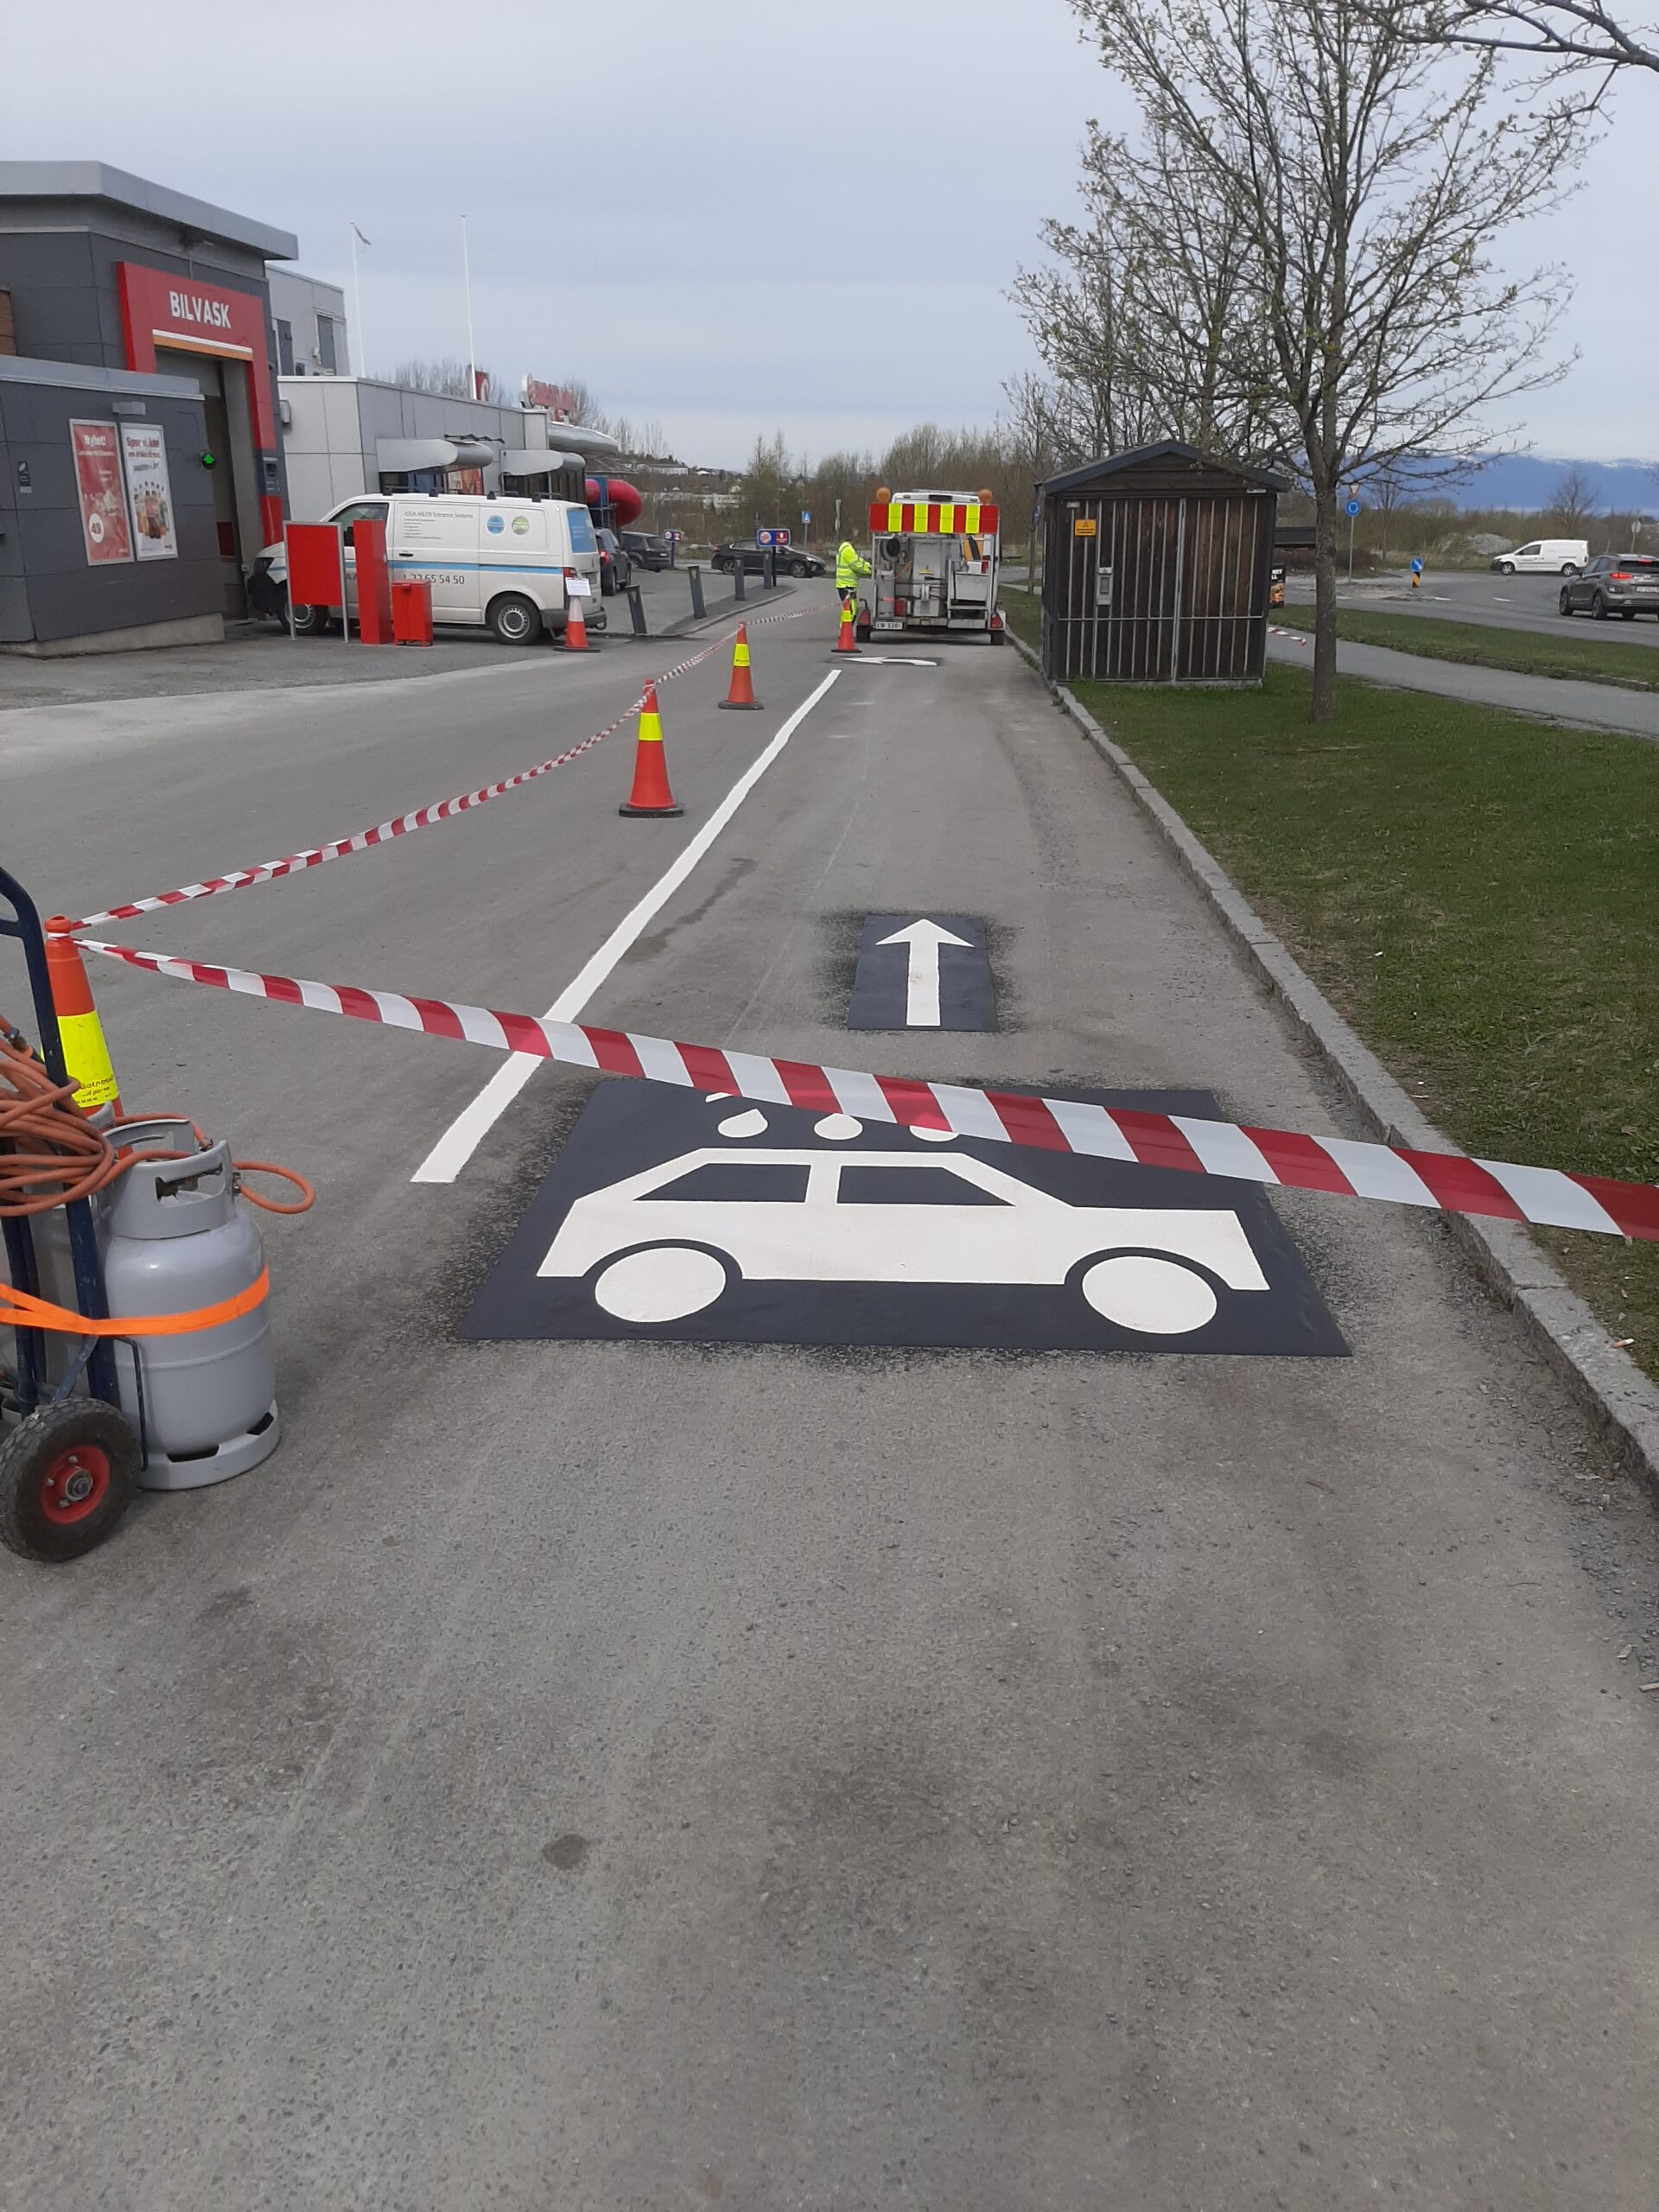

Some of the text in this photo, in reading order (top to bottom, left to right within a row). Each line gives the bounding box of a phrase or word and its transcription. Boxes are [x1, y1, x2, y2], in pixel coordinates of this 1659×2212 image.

[169, 290, 232, 329] BILVASK
[439, 574, 450, 584] 54
[453, 575, 465, 585] 50
